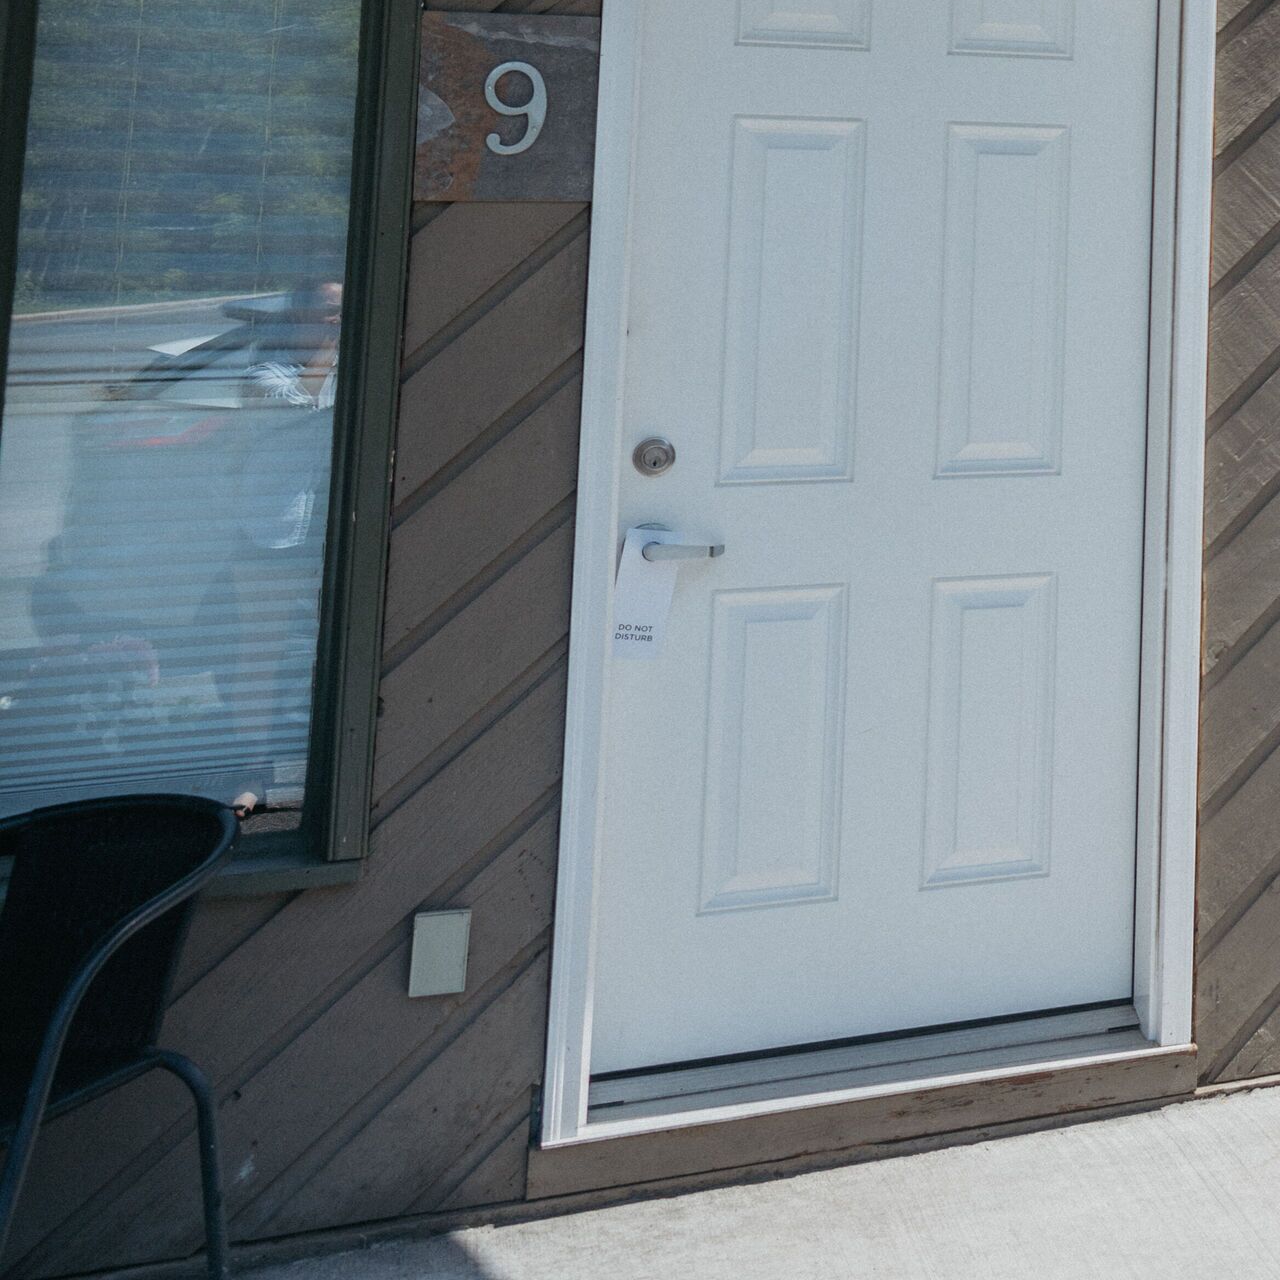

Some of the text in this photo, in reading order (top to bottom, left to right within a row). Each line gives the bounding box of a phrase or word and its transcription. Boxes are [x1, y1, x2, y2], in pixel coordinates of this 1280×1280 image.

[484, 61, 548, 155] 9
[618, 623, 653, 632] DO NOT
[615, 633, 653, 641] DISTURB
